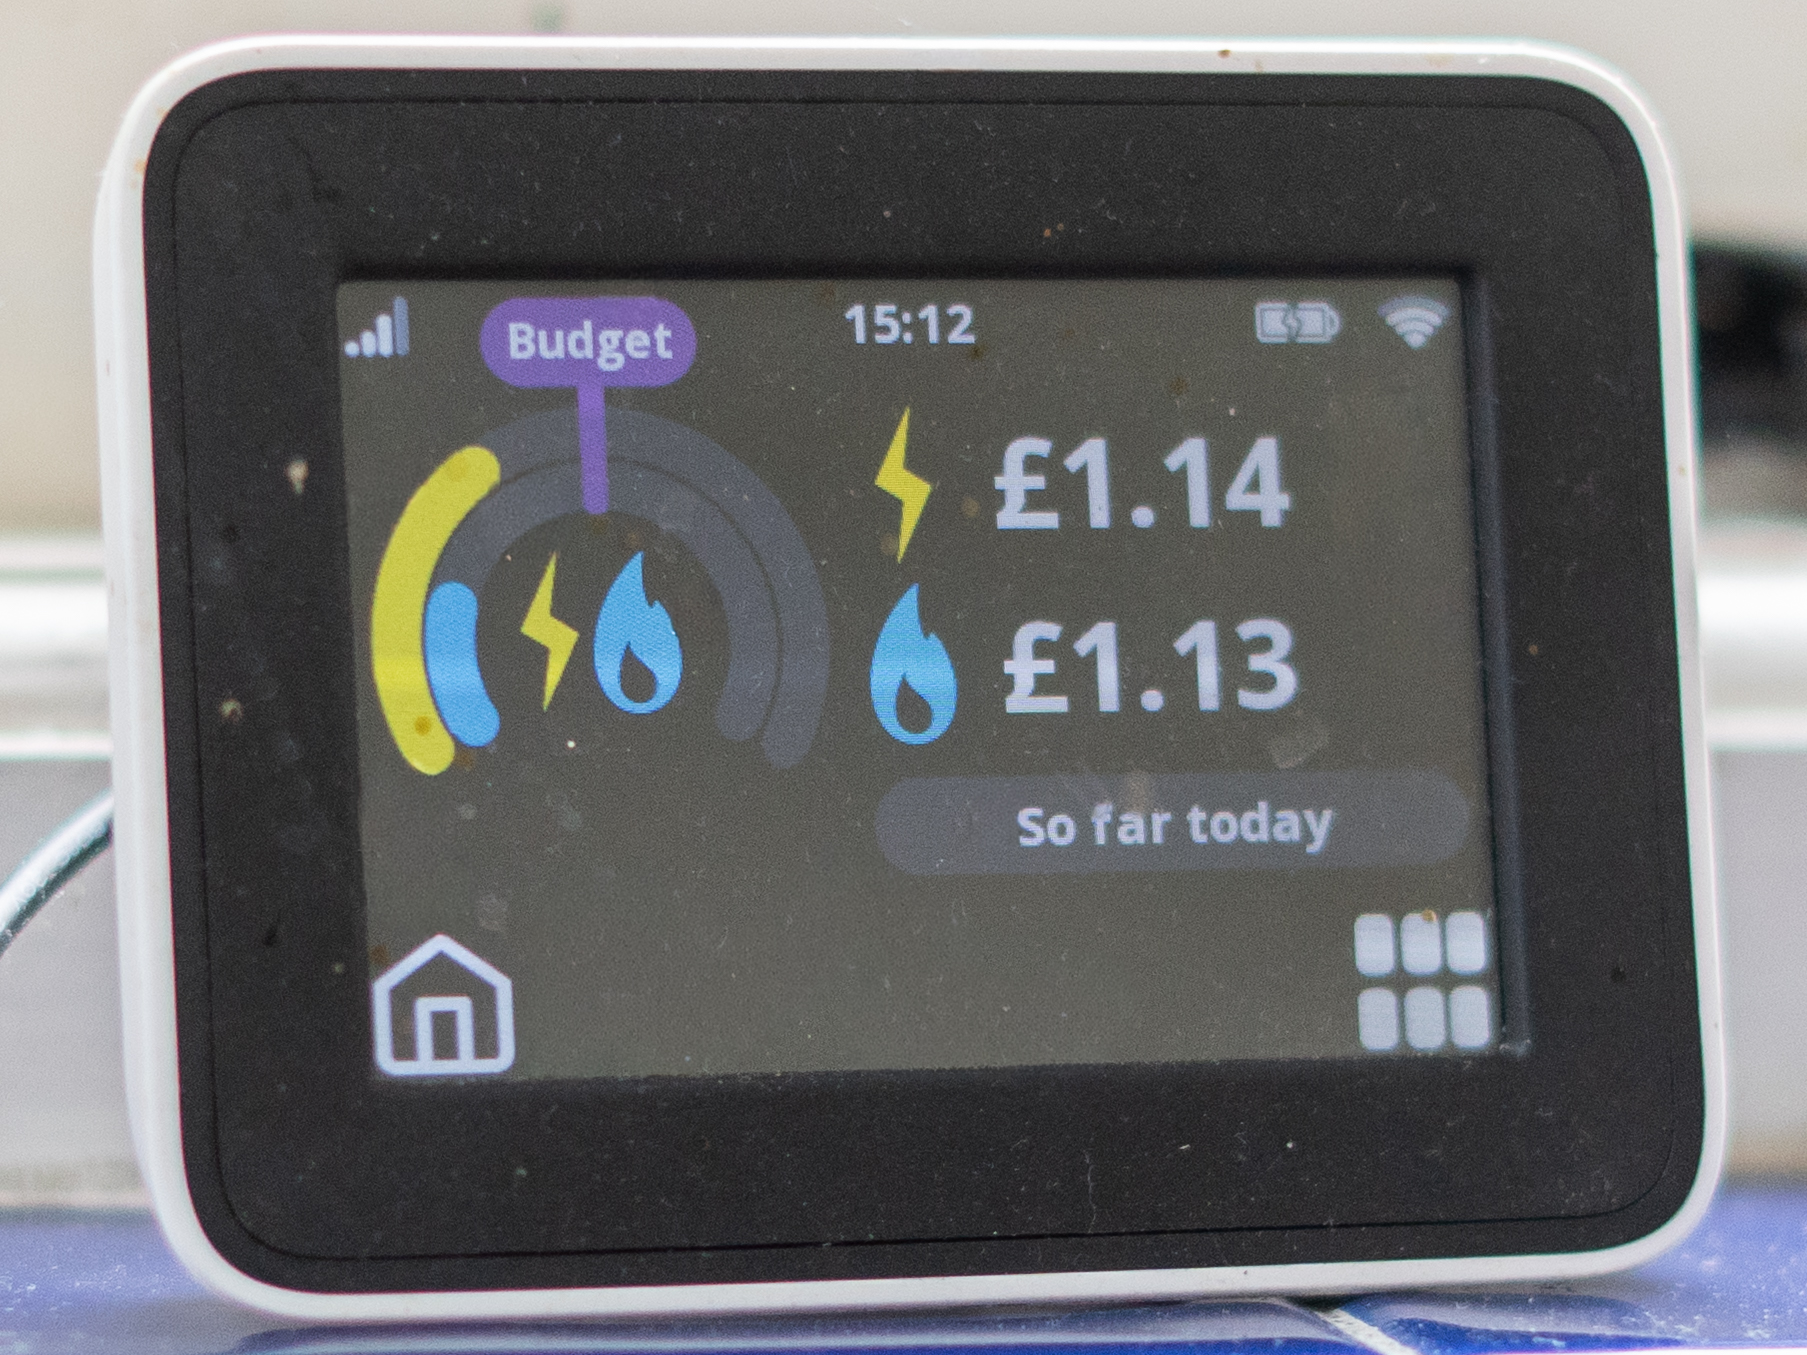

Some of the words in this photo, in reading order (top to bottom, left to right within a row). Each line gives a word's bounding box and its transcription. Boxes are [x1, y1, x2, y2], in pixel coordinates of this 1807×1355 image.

[507, 320, 673, 372] Budget
[845, 304, 976, 344] 15:12
[993, 437, 1290, 530] £1.14
[1003, 618, 1300, 714] £1.13
[1017, 807, 1077, 847] So
[1091, 803, 1172, 845] far
[1186, 801, 1333, 854] today
